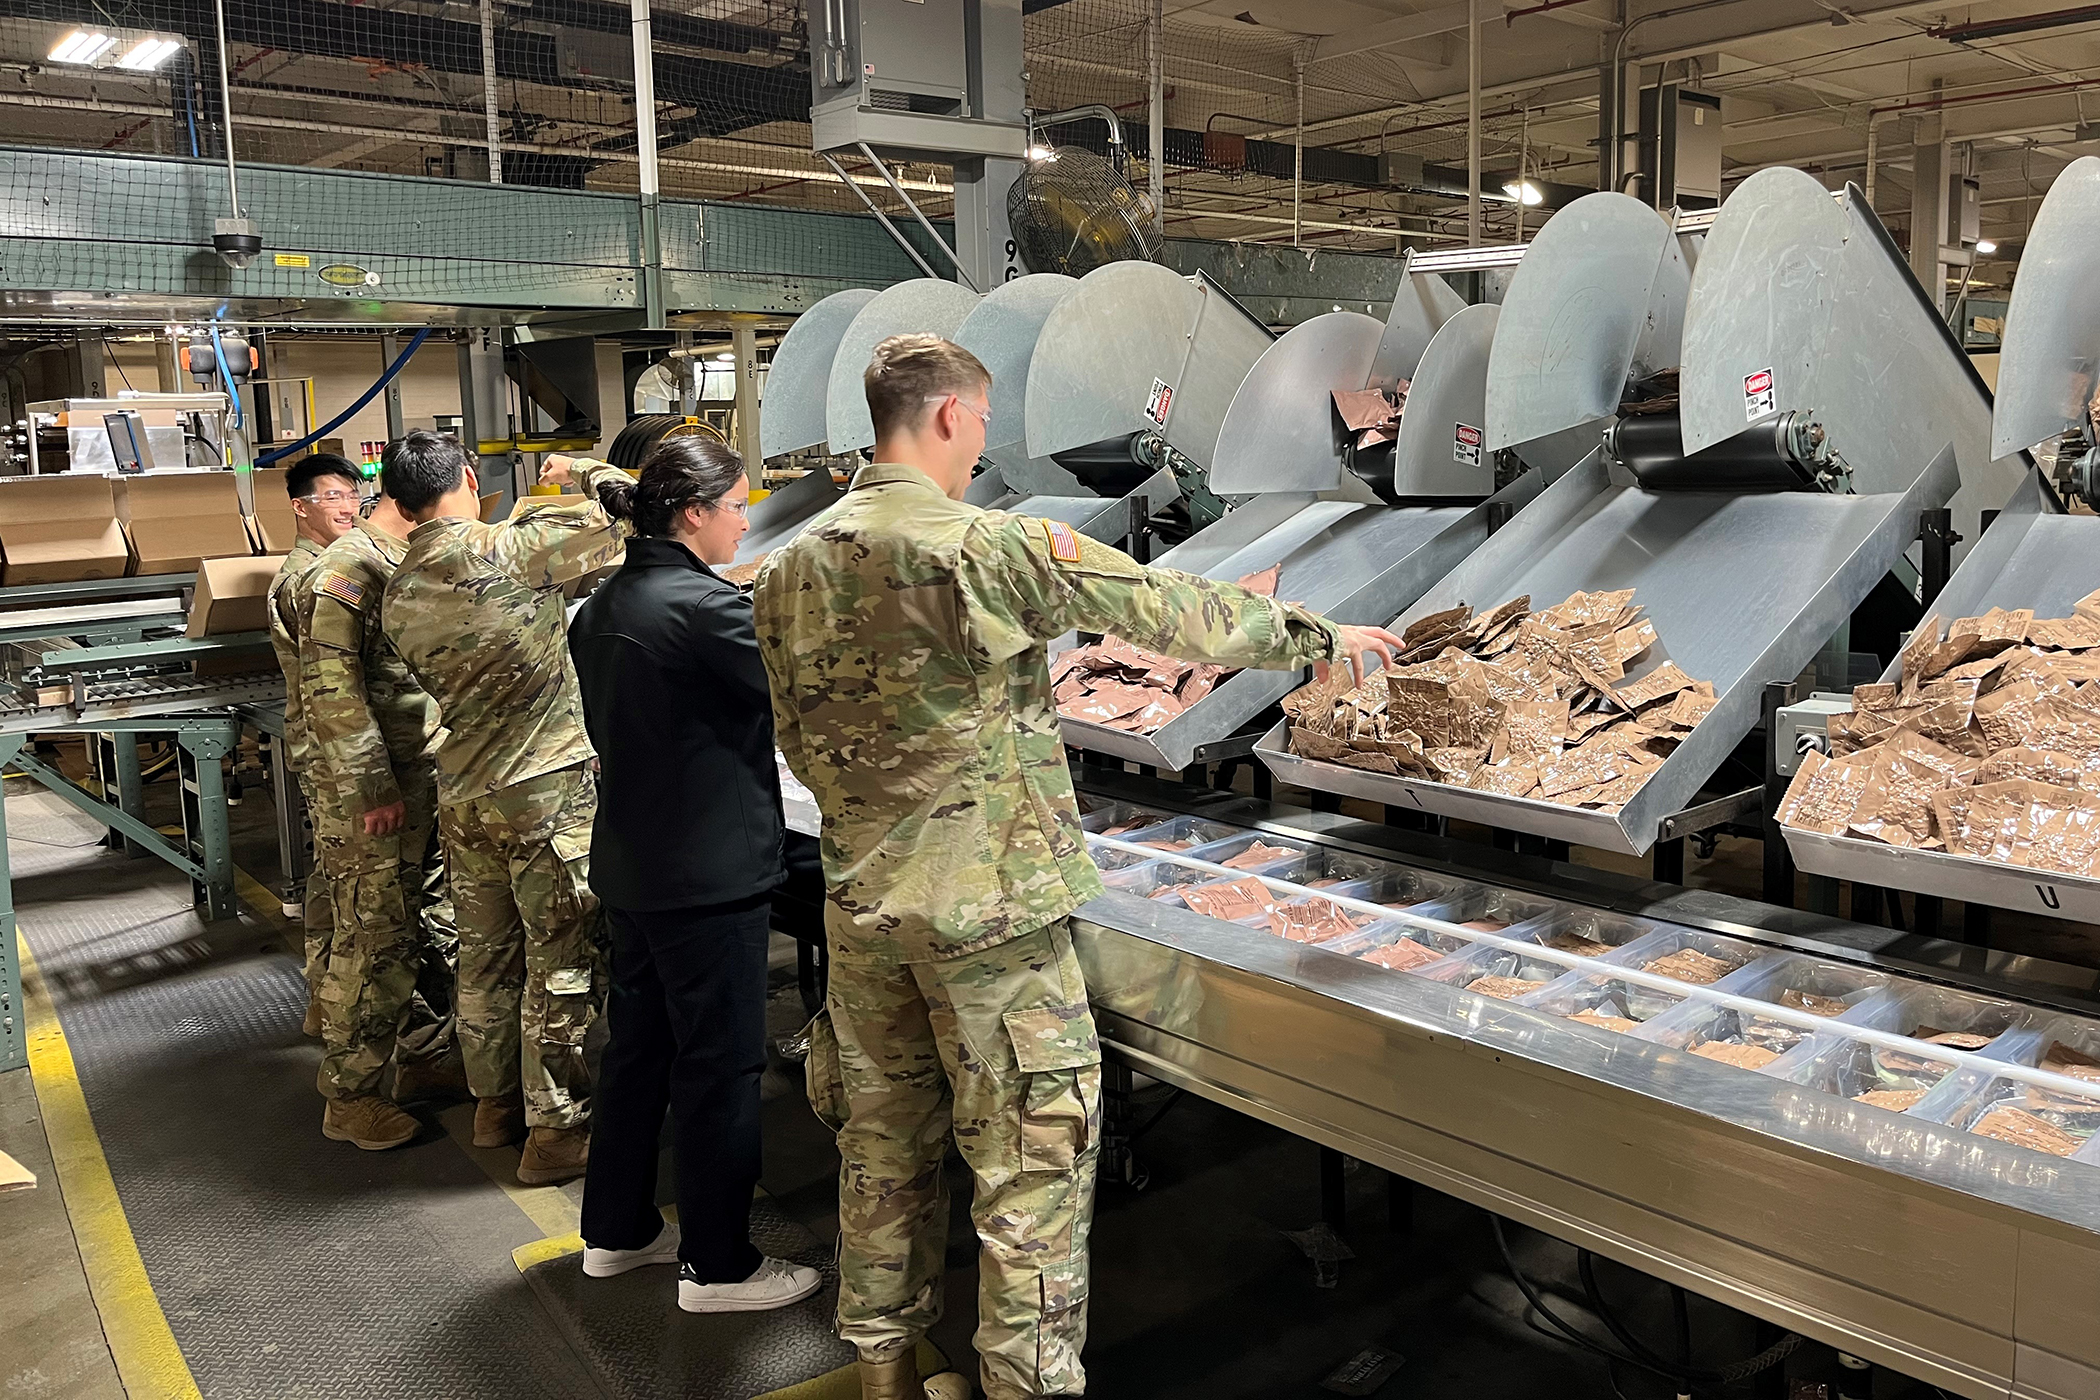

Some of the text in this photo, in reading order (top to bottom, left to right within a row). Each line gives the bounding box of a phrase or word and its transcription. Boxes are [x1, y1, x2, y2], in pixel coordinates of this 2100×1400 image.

[1748, 375, 1769, 390] DANGER
[1158, 390, 1170, 418] DANGER
[1747, 396, 1759, 407] PINCH
[1748, 405, 1760, 417] POINT
[1459, 430, 1479, 442] DANGER
[2034, 884, 2060, 909] U
